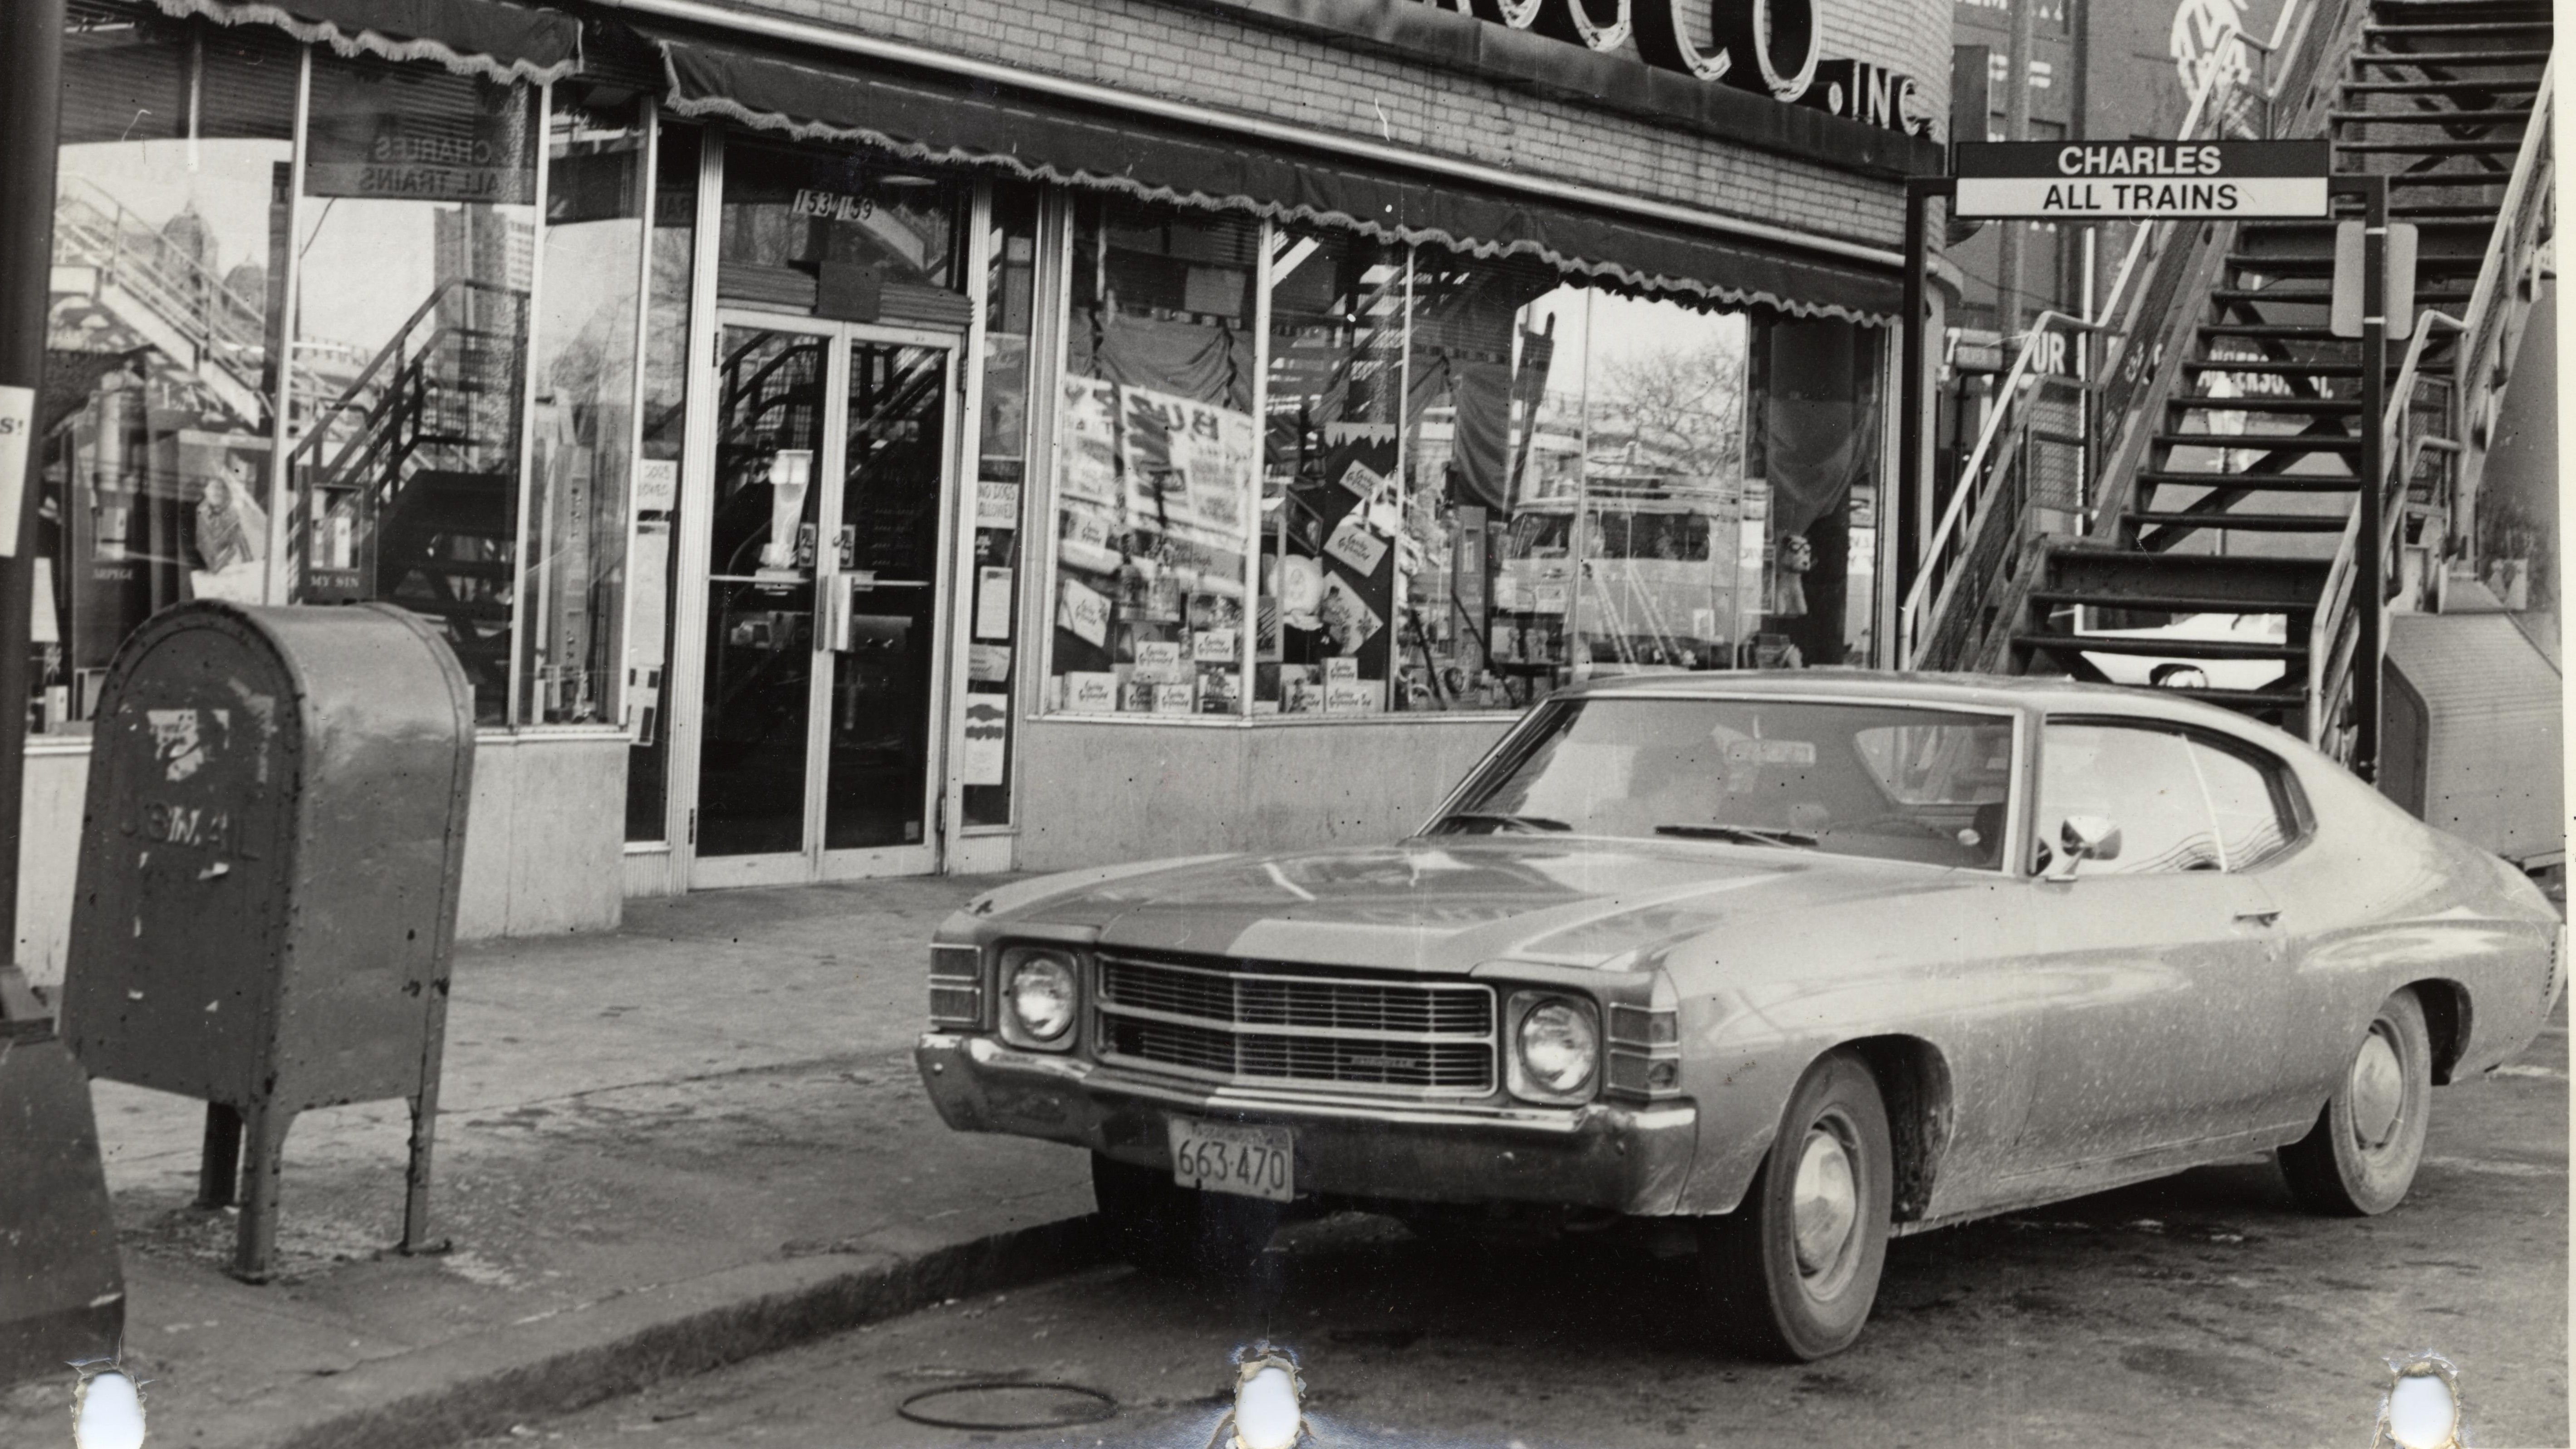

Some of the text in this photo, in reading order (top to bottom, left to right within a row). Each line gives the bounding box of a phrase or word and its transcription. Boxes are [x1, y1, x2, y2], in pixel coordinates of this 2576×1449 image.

[2058, 146, 2221, 175] CHARLES
[2043, 183, 2238, 210] ALL TRAINS
[311, 575, 332, 587] MY
